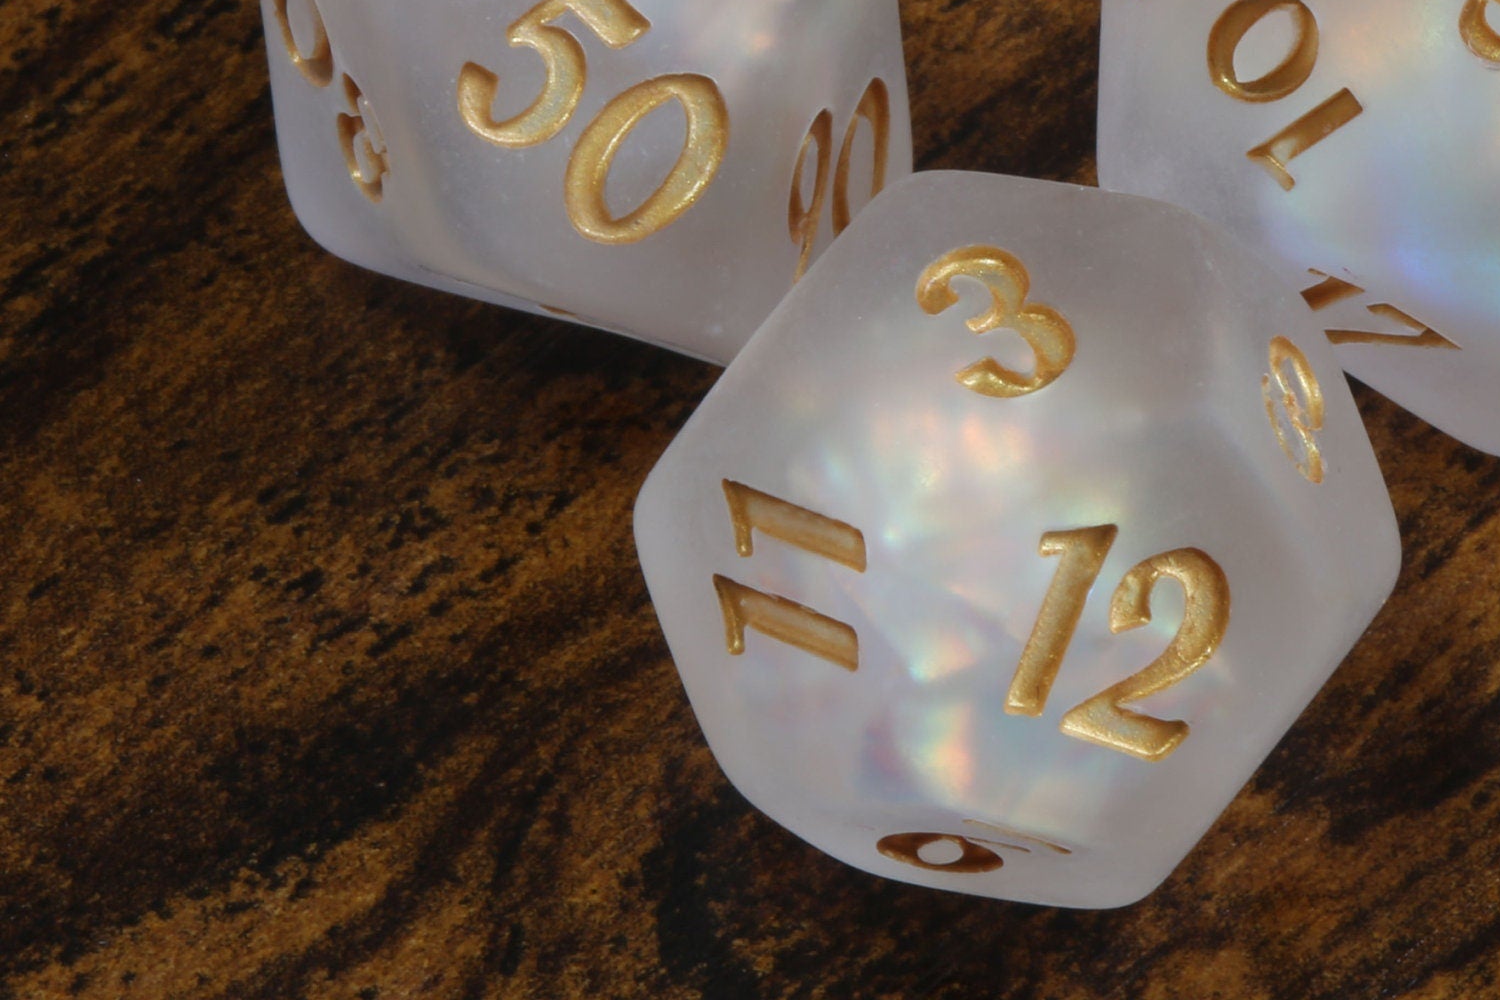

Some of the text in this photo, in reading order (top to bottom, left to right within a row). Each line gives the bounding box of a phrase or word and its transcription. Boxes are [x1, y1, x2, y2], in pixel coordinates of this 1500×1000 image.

[915, 244, 1077, 399] 3
[711, 477, 867, 673] 11
[1003, 521, 1231, 763] 12
